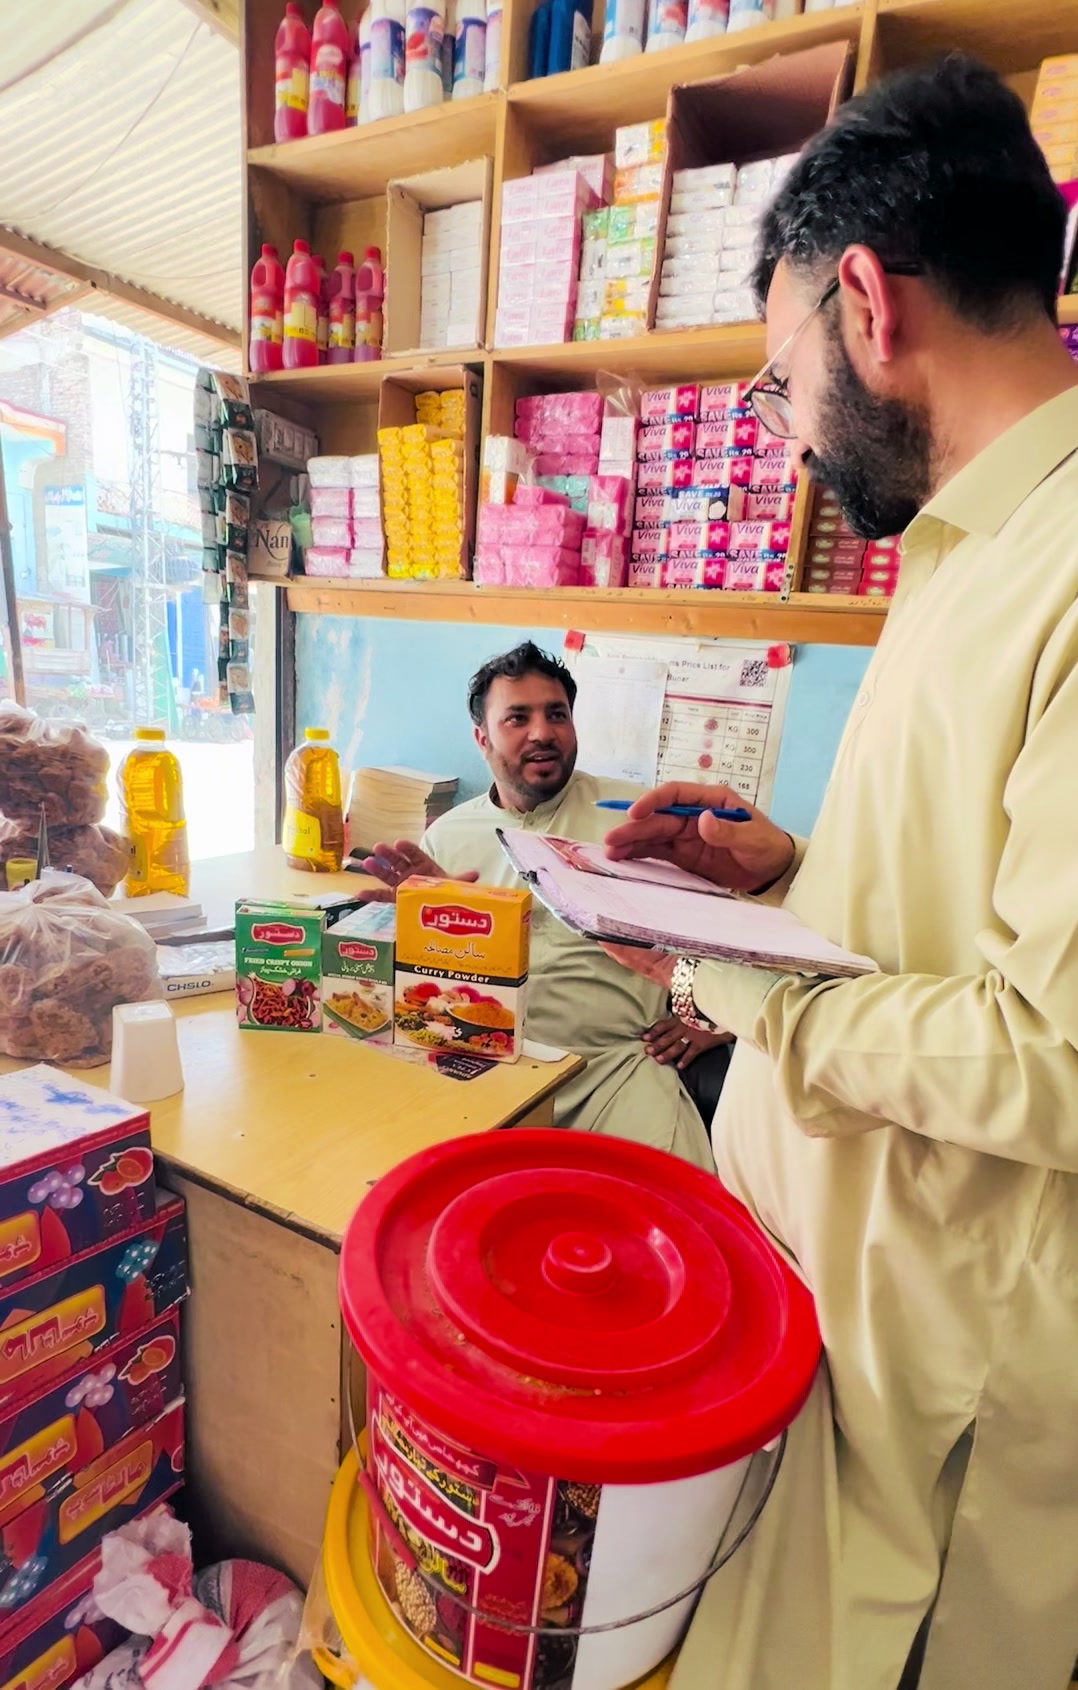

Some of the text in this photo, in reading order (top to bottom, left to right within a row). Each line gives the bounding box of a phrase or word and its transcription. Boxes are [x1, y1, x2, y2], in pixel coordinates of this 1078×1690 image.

[647, 390, 671, 401] Viva
[706, 386, 732, 396] Viva
[642, 415, 671, 427] SAVE
[700, 411, 731, 423] SAVE
[643, 427, 667, 438] Viva
[703, 423, 729, 433] Viva
[638, 452, 667, 463] SAVE
[697, 448, 728, 458] SAVE
[643, 463, 667, 474] Viva
[699, 460, 725, 471] Viva
[759, 458, 786, 470] Viva
[678, 490, 705, 499] SAVE
[752, 484, 785, 494] SAVE
[641, 497, 665, 508] Viva
[675, 499, 701, 511] Viva
[755, 494, 782, 505] Viva
[676, 524, 703, 535] Viva
[737, 522, 765, 534] Viva
[638, 530, 661, 541] Viva
[255, 526, 289, 560] Nan
[671, 550, 700, 559] SAVE
[729, 550, 762, 559] SAVE
[632, 563, 655, 574] Viva
[673, 559, 698, 570] Viva
[732, 563, 759, 574] Viva
[681, 660, 701, 669] Price
[703, 662, 719, 671] List
[728, 725, 739, 734] KG
[746, 727, 760, 737] 300
[743, 745, 757, 755] 300
[739, 764, 753, 773] 230
[427, 912, 488, 929] دستور
[258, 927, 301, 939] دستور
[342, 946, 375, 957] دستور
[244, 957, 265, 965] FRIED
[414, 965, 445, 978] Curry
[448, 971, 490, 983] Powder
[376, 1452, 483, 1552] دستور
